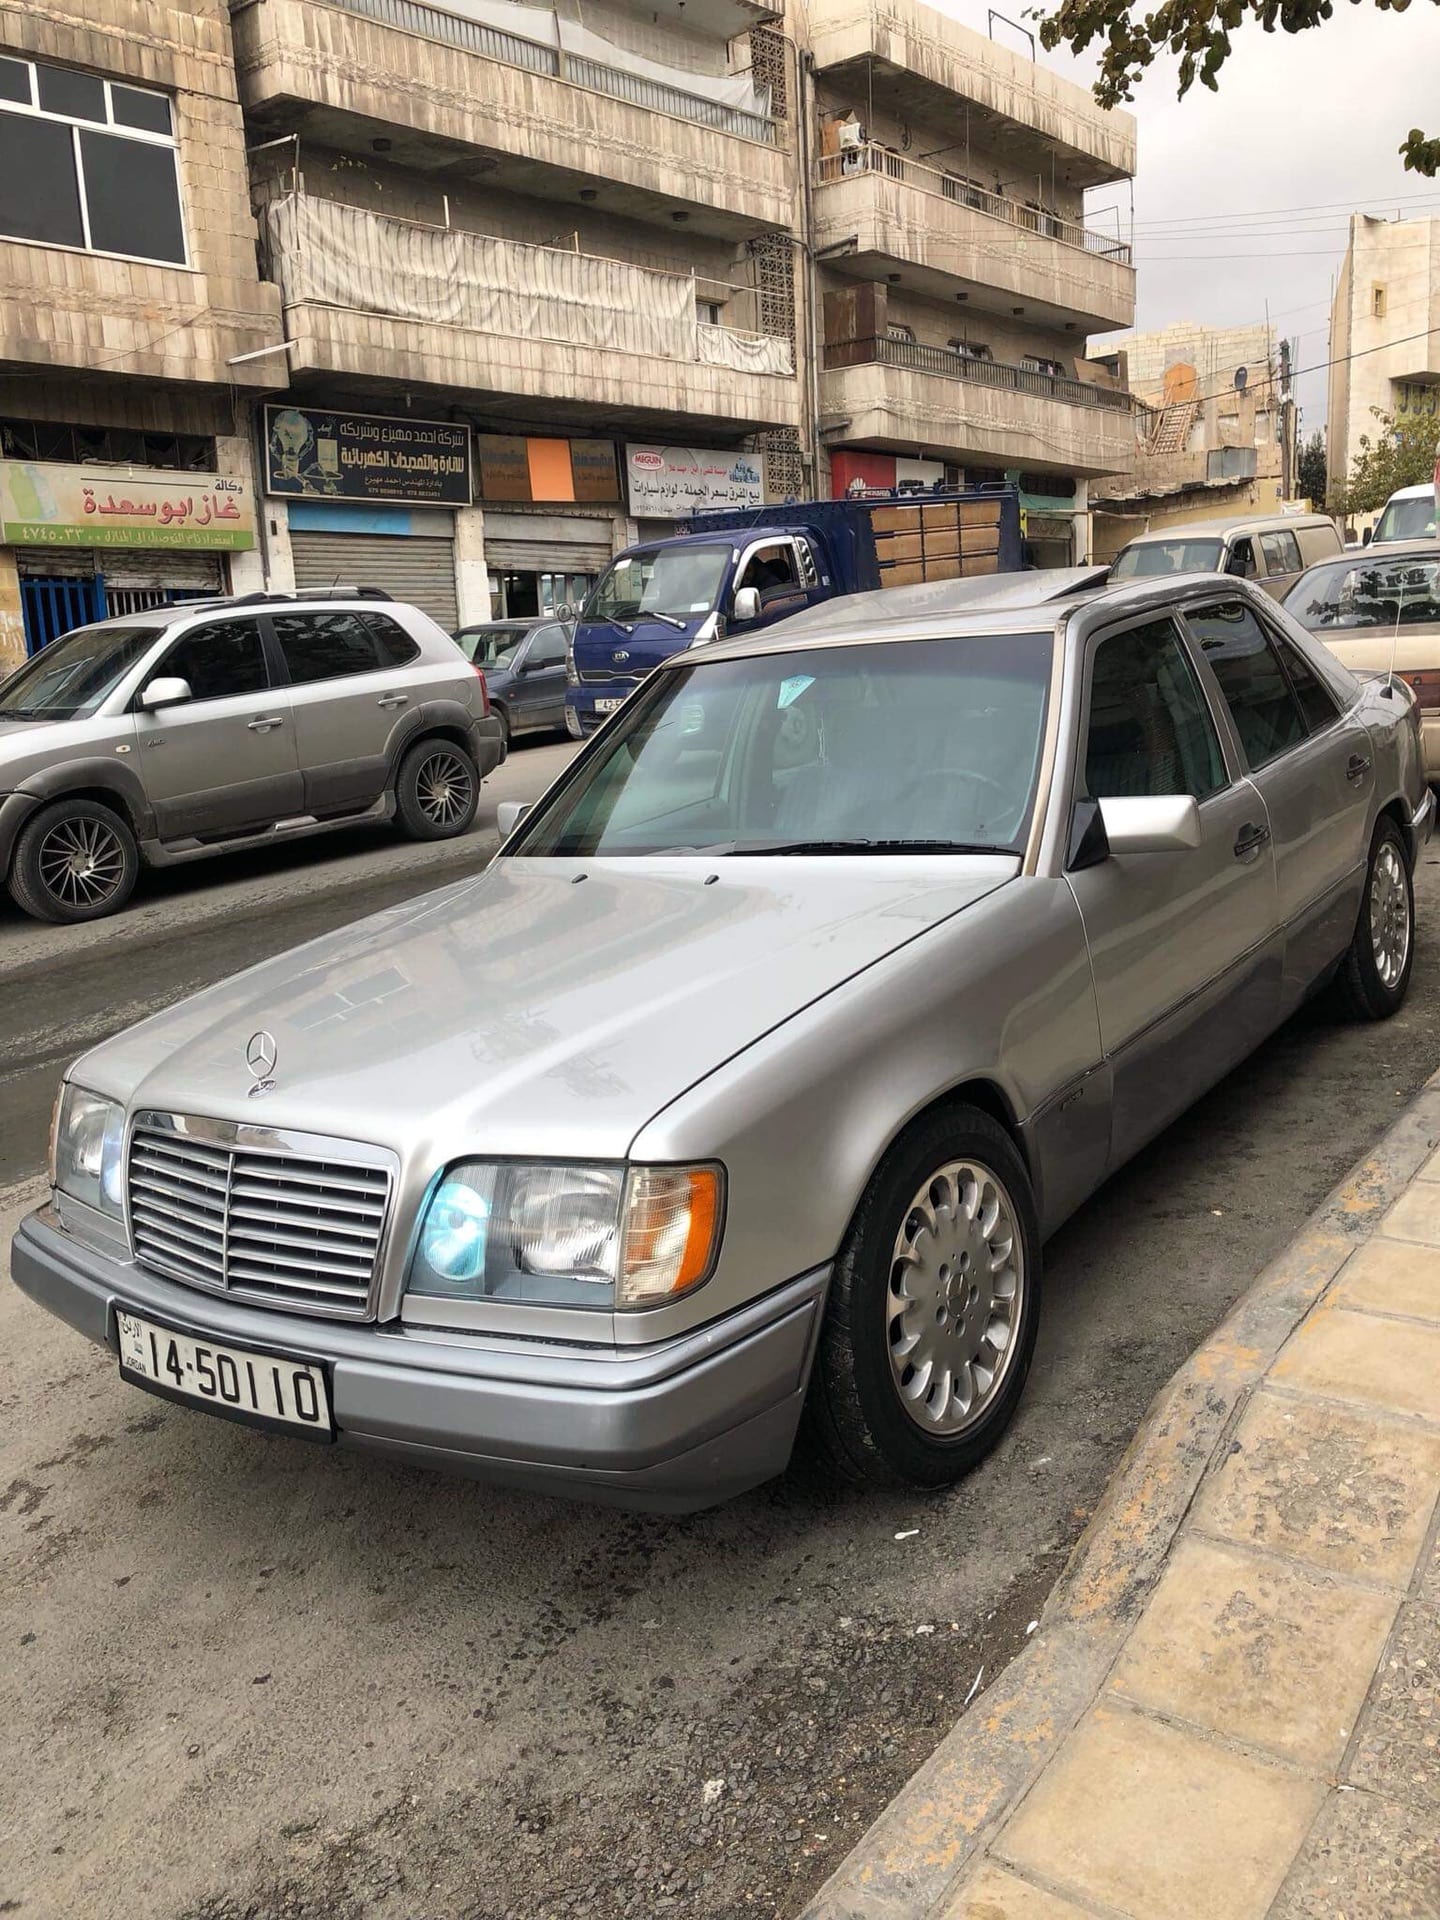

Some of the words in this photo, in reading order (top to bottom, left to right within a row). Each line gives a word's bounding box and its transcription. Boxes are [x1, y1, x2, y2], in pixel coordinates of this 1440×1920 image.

[340, 422, 379, 441] وشريكه
[414, 430, 436, 444] احمد
[438, 429, 464, 448] شركة
[341, 447, 389, 469] الكهربائية
[391, 451, 439, 474] والتمديدات
[635, 455, 662, 465] MEGUIN
[214, 479, 243, 494] وكالة
[634, 480, 660, 497] سيارات
[660, 483, 678, 498] لوازم
[685, 483, 709, 499] الجملة
[83, 488, 157, 516] سعدة
[749, 490, 760, 504] بيع
[158, 497, 192, 524] ابو
[196, 494, 241, 524] غاز
[126, 1355, 147, 1374] JORDAN
[149, 1331, 319, 1422] 14-50110
